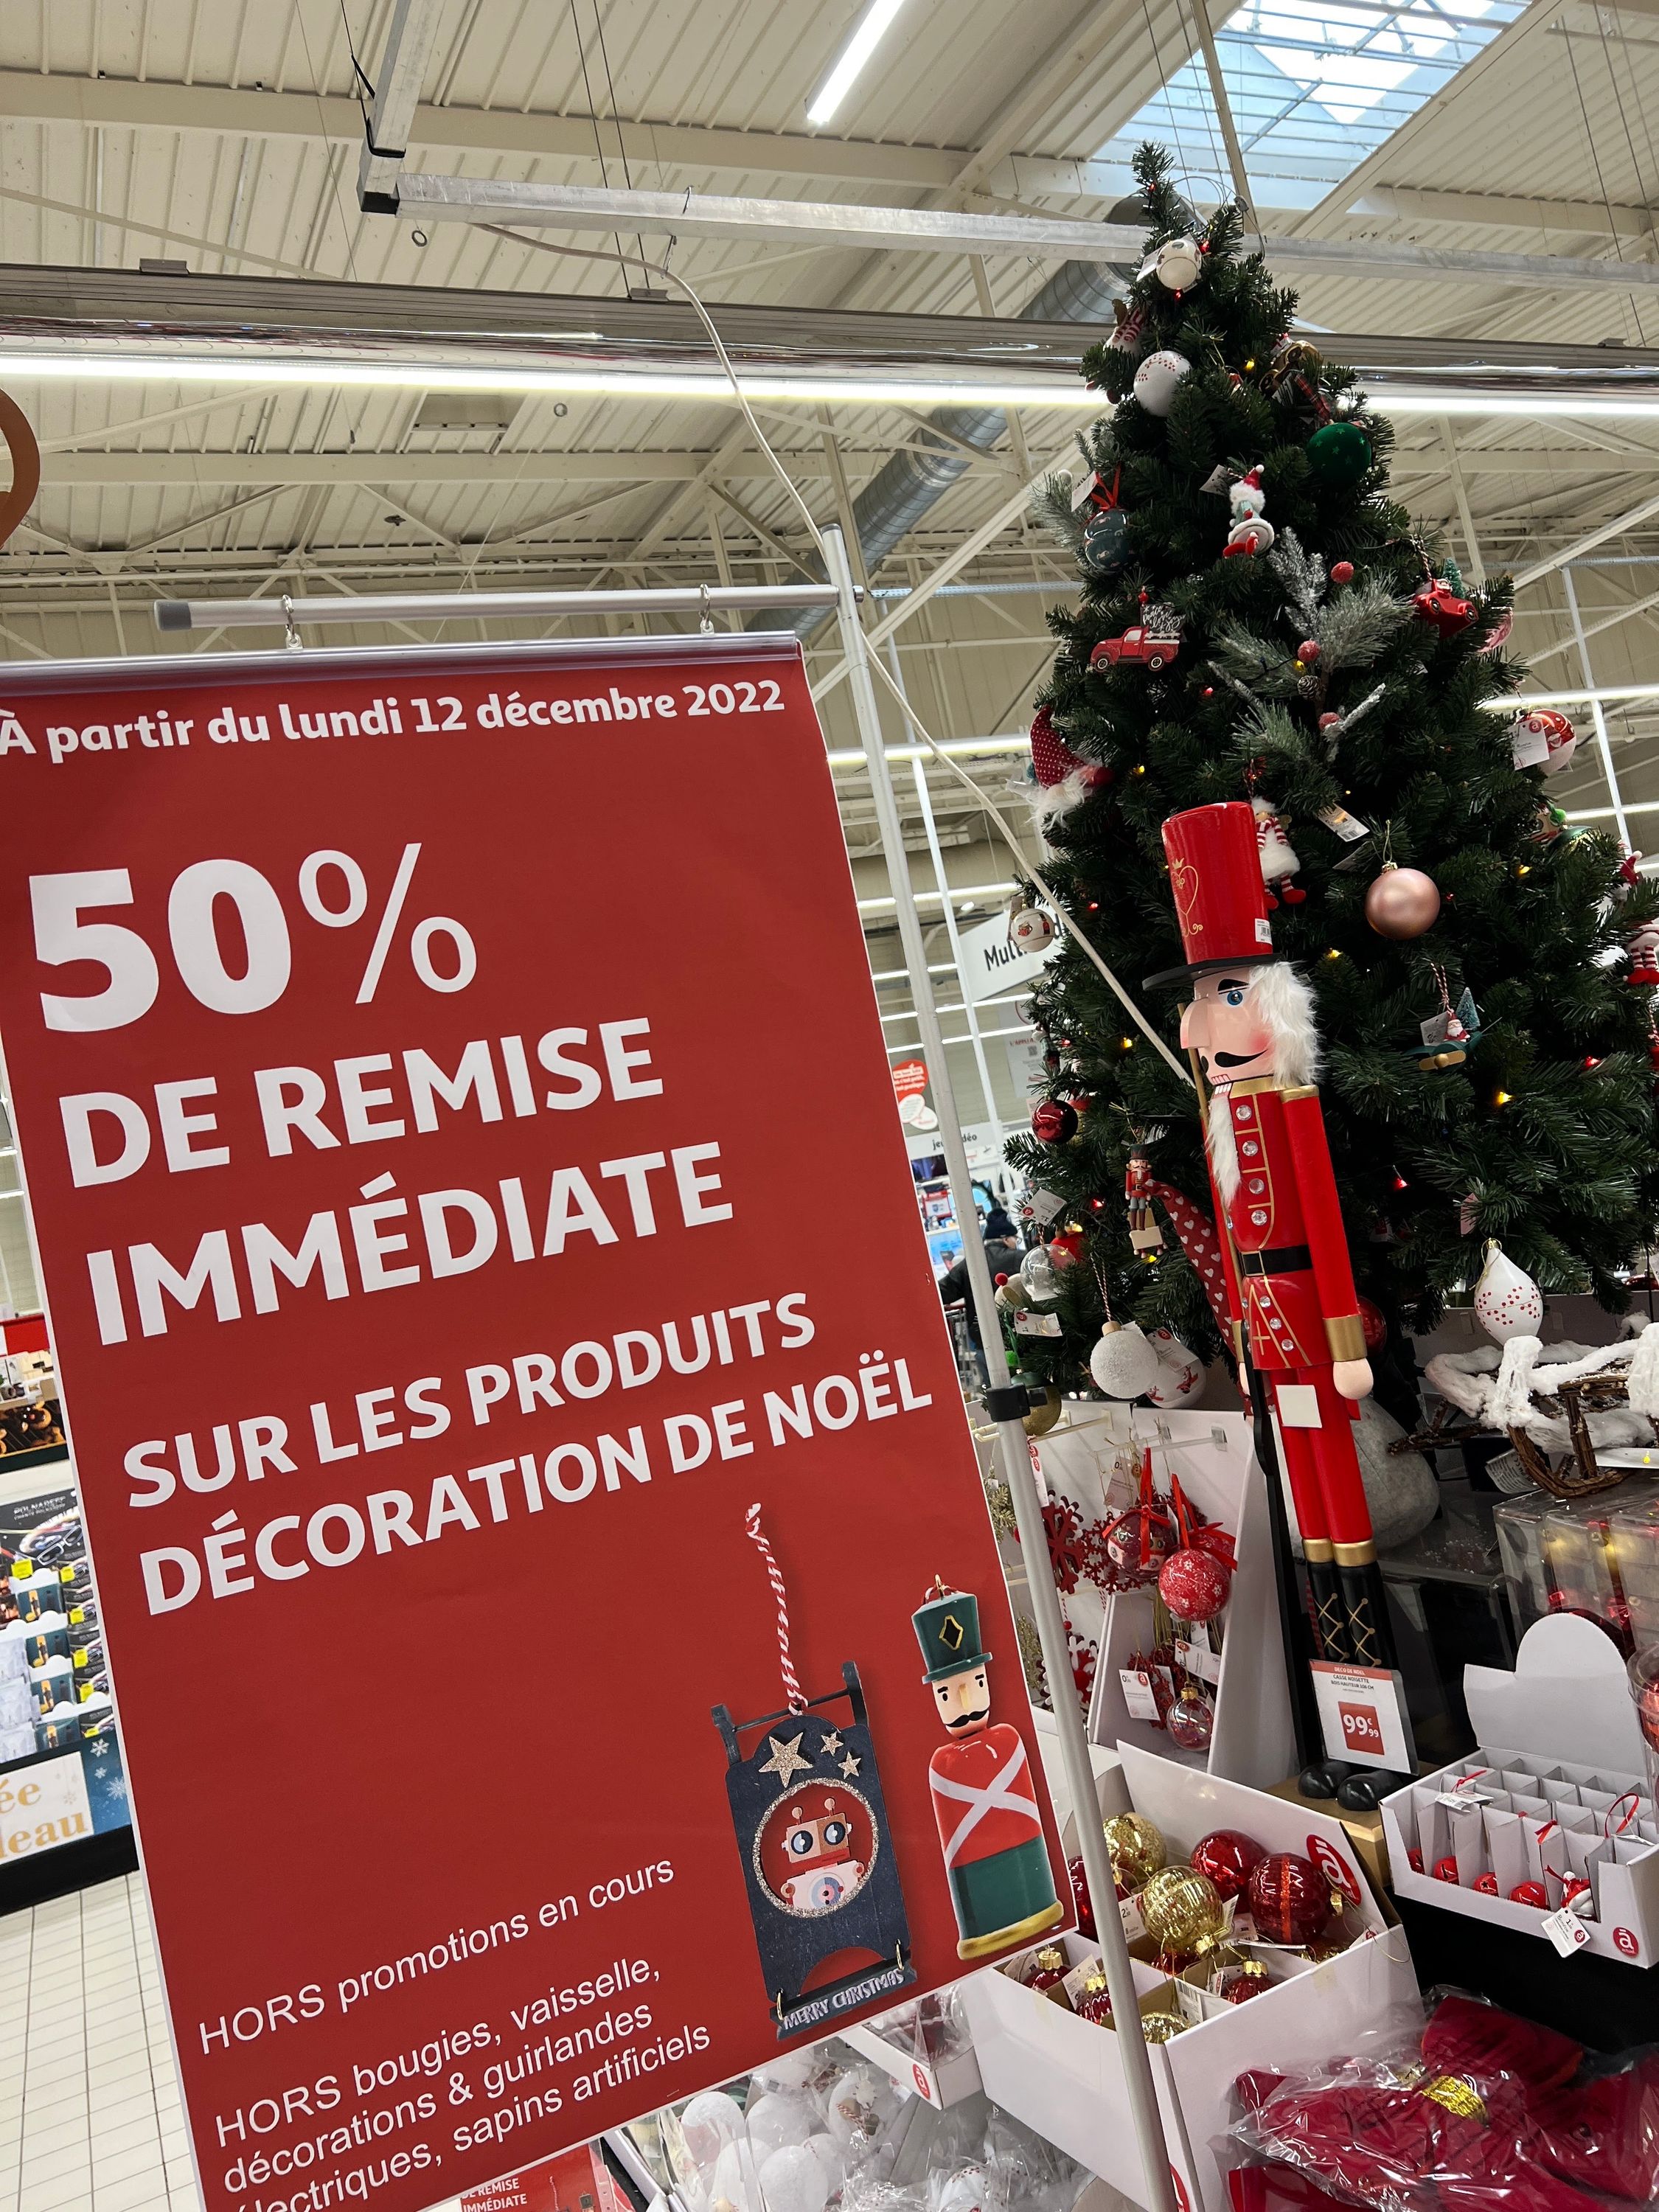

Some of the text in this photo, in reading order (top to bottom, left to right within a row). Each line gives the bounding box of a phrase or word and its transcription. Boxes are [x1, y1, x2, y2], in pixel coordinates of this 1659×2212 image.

[0, 679, 785, 764] À partir du lundi 12 décembre 2022
[29, 842, 477, 1032] 50%
[58, 1017, 664, 1189] DE REMISE
[86, 1141, 734, 1346] IMMÉDIATE
[123, 1292, 815, 1508] SUR LES PRODUITS
[139, 1349, 933, 1616] DÉCORATION DE NOËL
[0, 1812, 88, 1859] eau
[199, 1860, 674, 2055] HORS promotions en cours
[783, 1969, 905, 2030] MERRY CHRISTMAS
[215, 1958, 660, 2148] HORS bougies, vaisselle,
[224, 2004, 653, 2193] décorations & guirlandes
[238, 2025, 710, 2212] ectriques, sapins artificiels
[463, 2193, 528, 2212] IMMÉDIATE
[478, 2177, 520, 2197] REMISE
